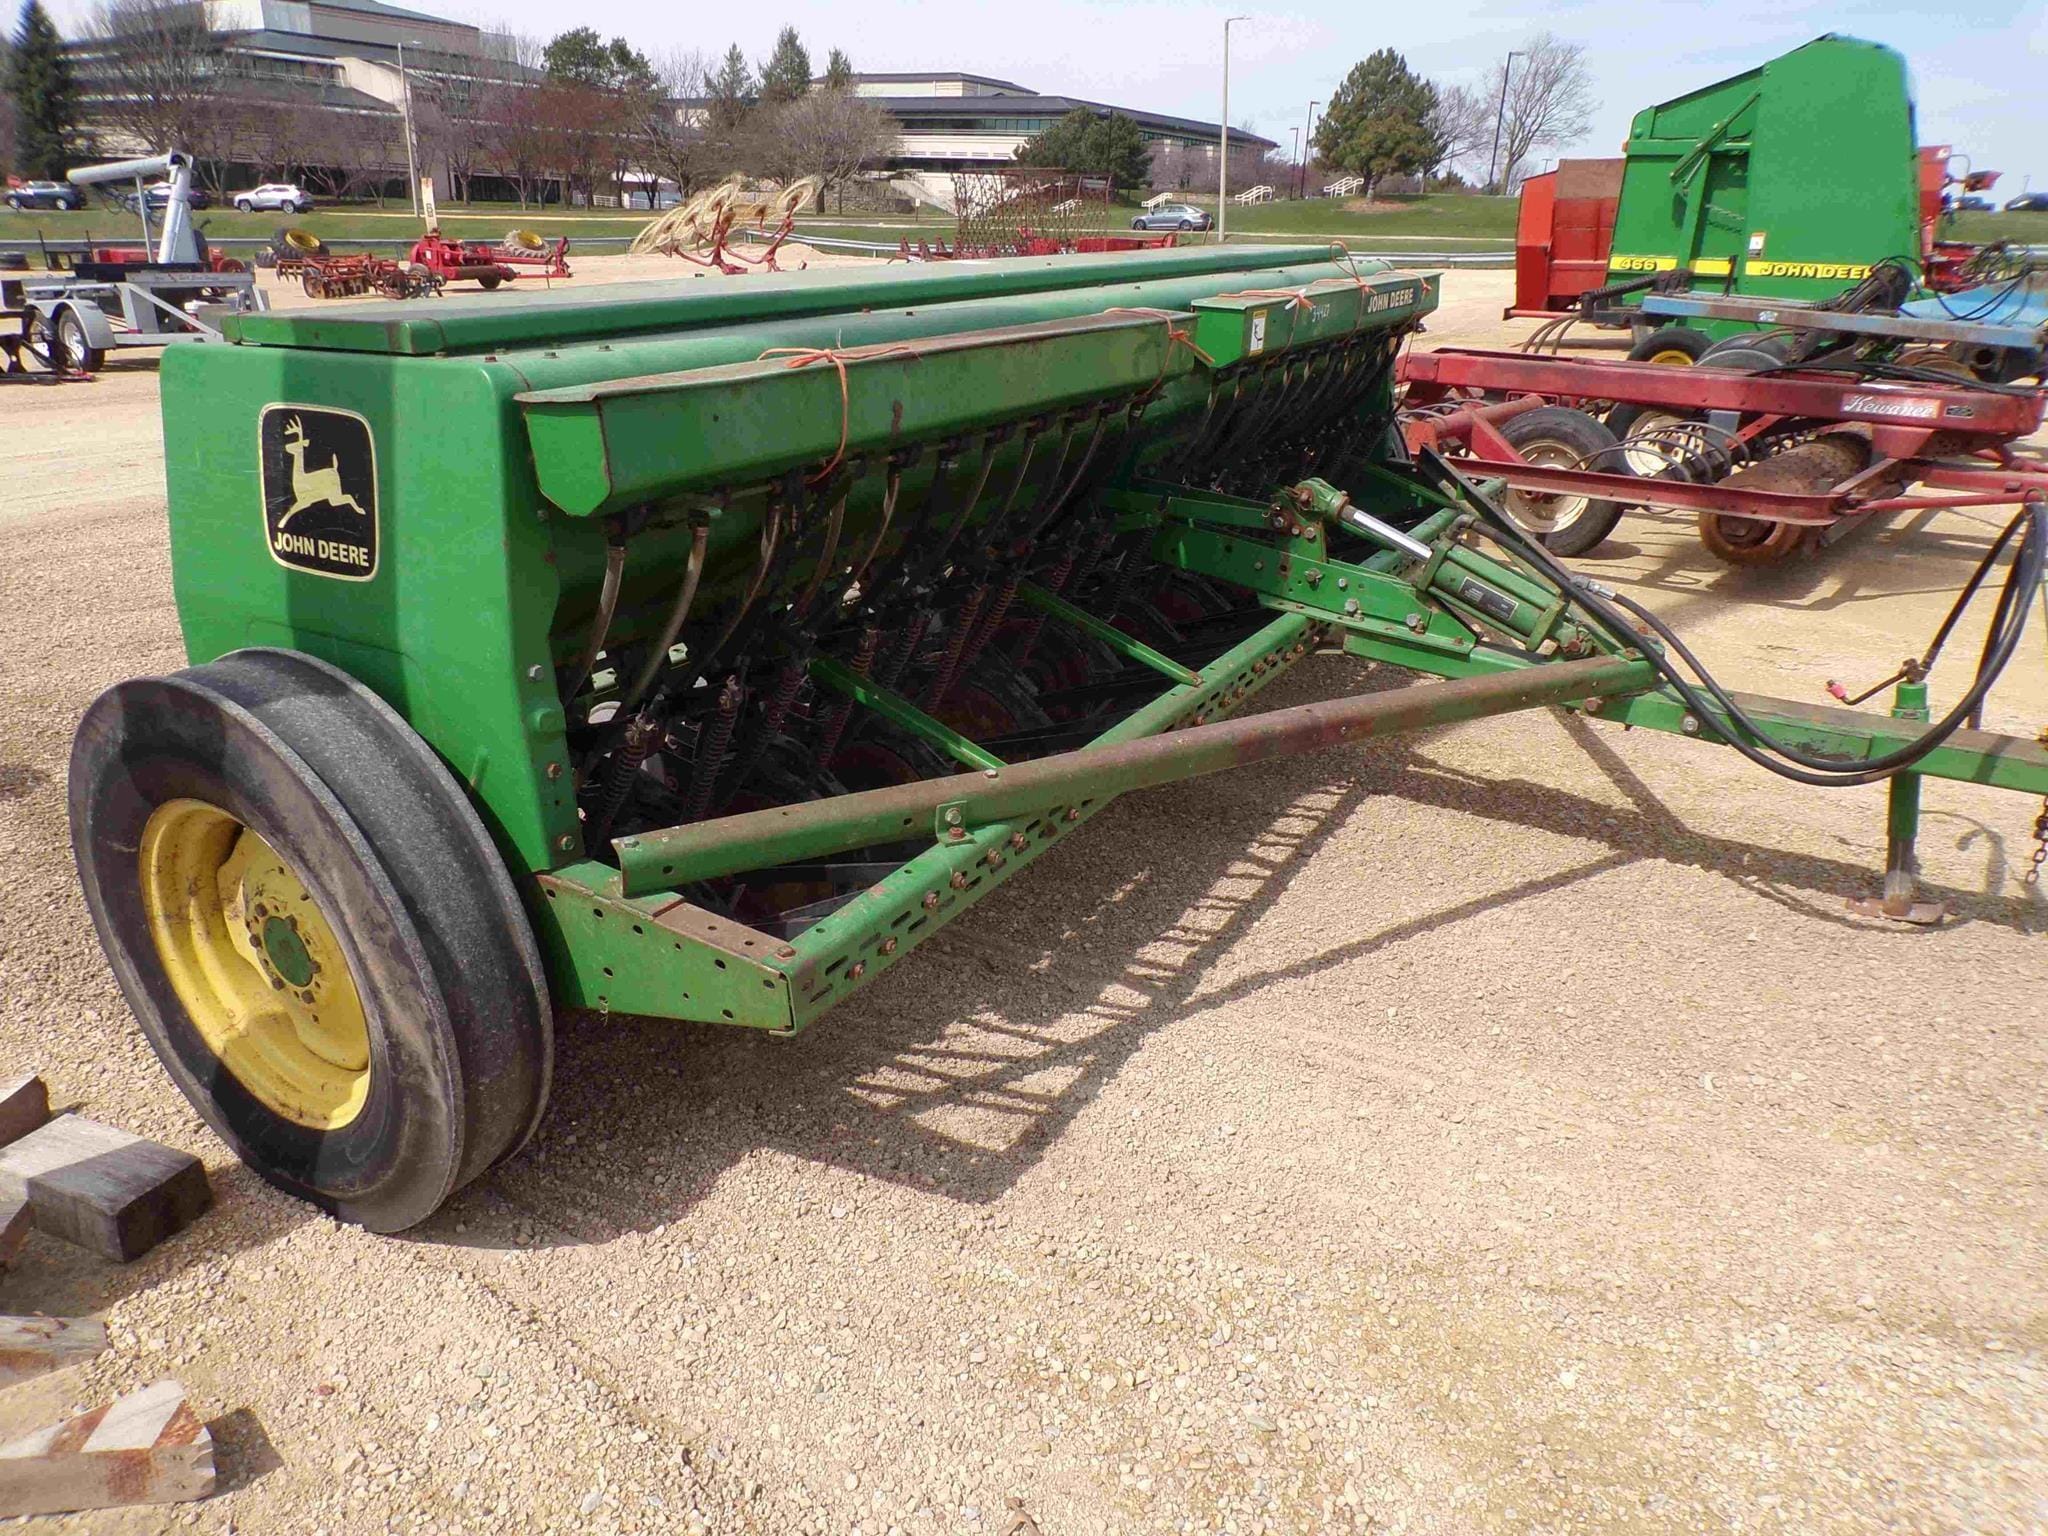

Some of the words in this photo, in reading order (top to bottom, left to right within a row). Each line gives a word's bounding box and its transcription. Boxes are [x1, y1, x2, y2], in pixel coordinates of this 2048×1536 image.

[1620, 258, 1657, 271] 466
[1761, 263, 1818, 279] JOHN
[1367, 292, 1389, 314] JOHN
[1390, 287, 1414, 308] DEERE
[1843, 395, 1934, 418] Kewanee
[274, 532, 315, 557] JOHN
[318, 539, 370, 567] DEERE
